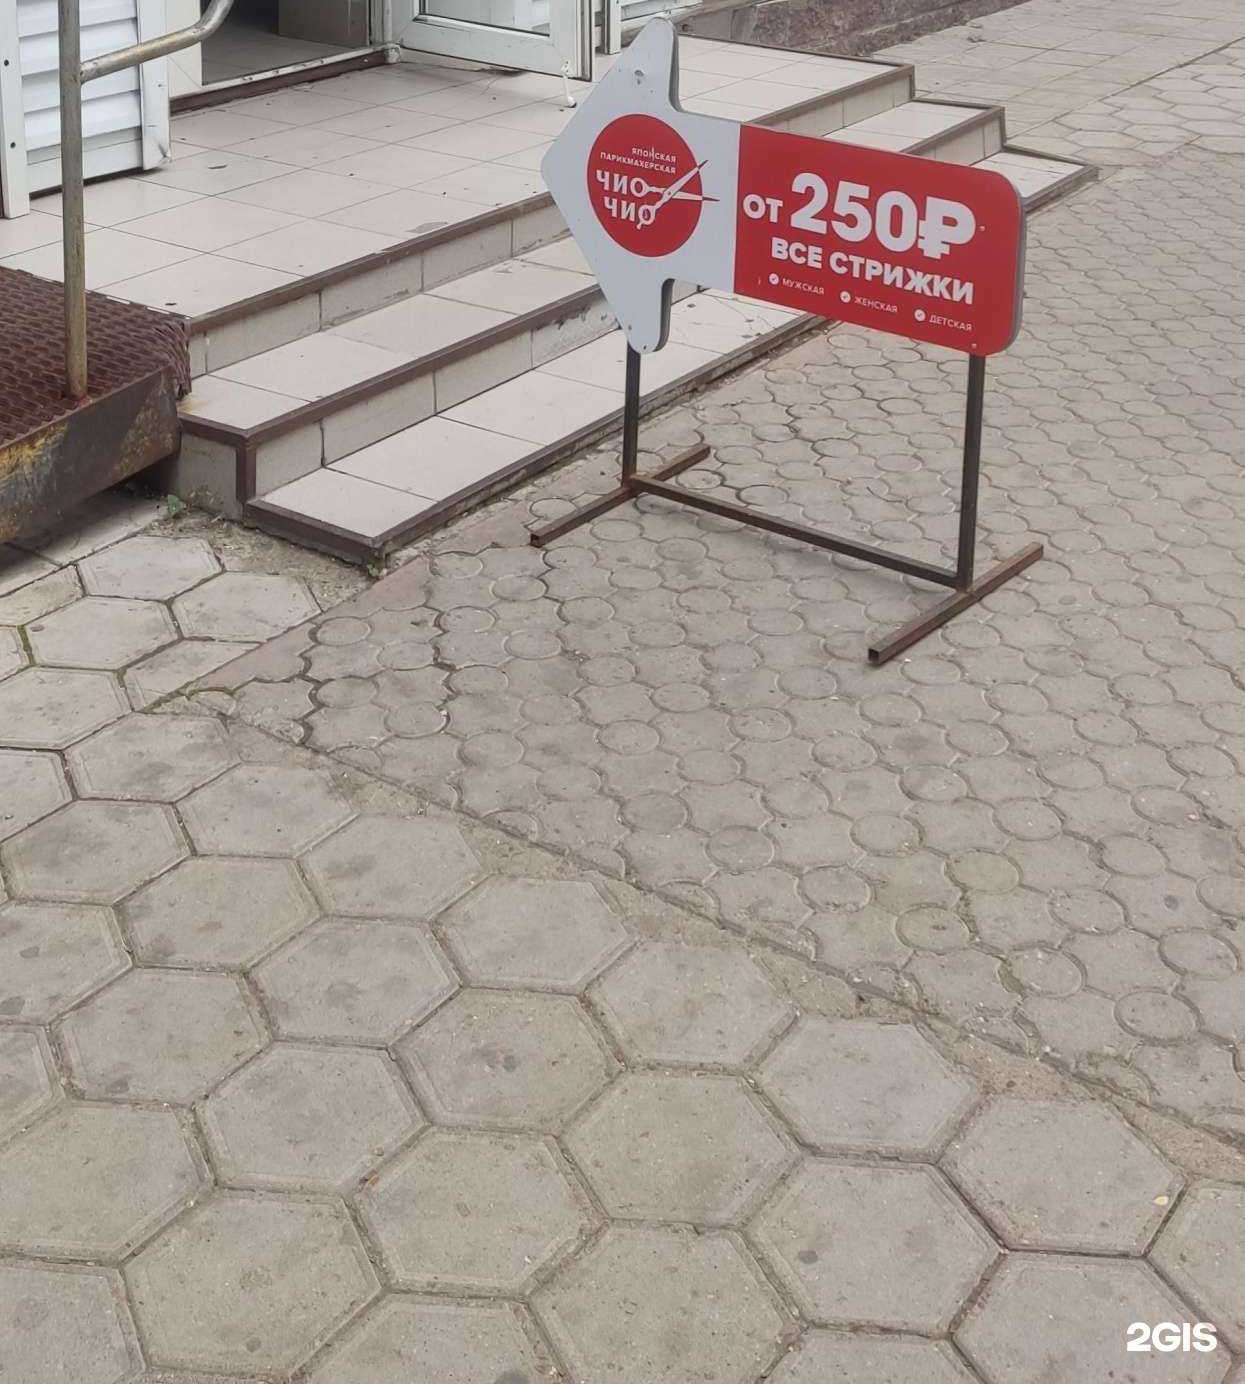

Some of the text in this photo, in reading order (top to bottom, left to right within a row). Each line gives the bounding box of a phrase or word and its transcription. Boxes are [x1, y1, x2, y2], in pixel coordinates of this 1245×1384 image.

[600, 151, 677, 174] ПАРИКМАХЕРСКАЯ
[631, 147, 677, 163] ЯПОНСКАЯ
[596, 169, 649, 198] ЧИО
[604, 196, 656, 229] ЧИО
[771, 236, 974, 305] ВСЕ СТРИЖКИ
[782, 277, 972, 332] МУЖСКАЯ ЖЕНСКАЯ ДЕТСКАЯ
